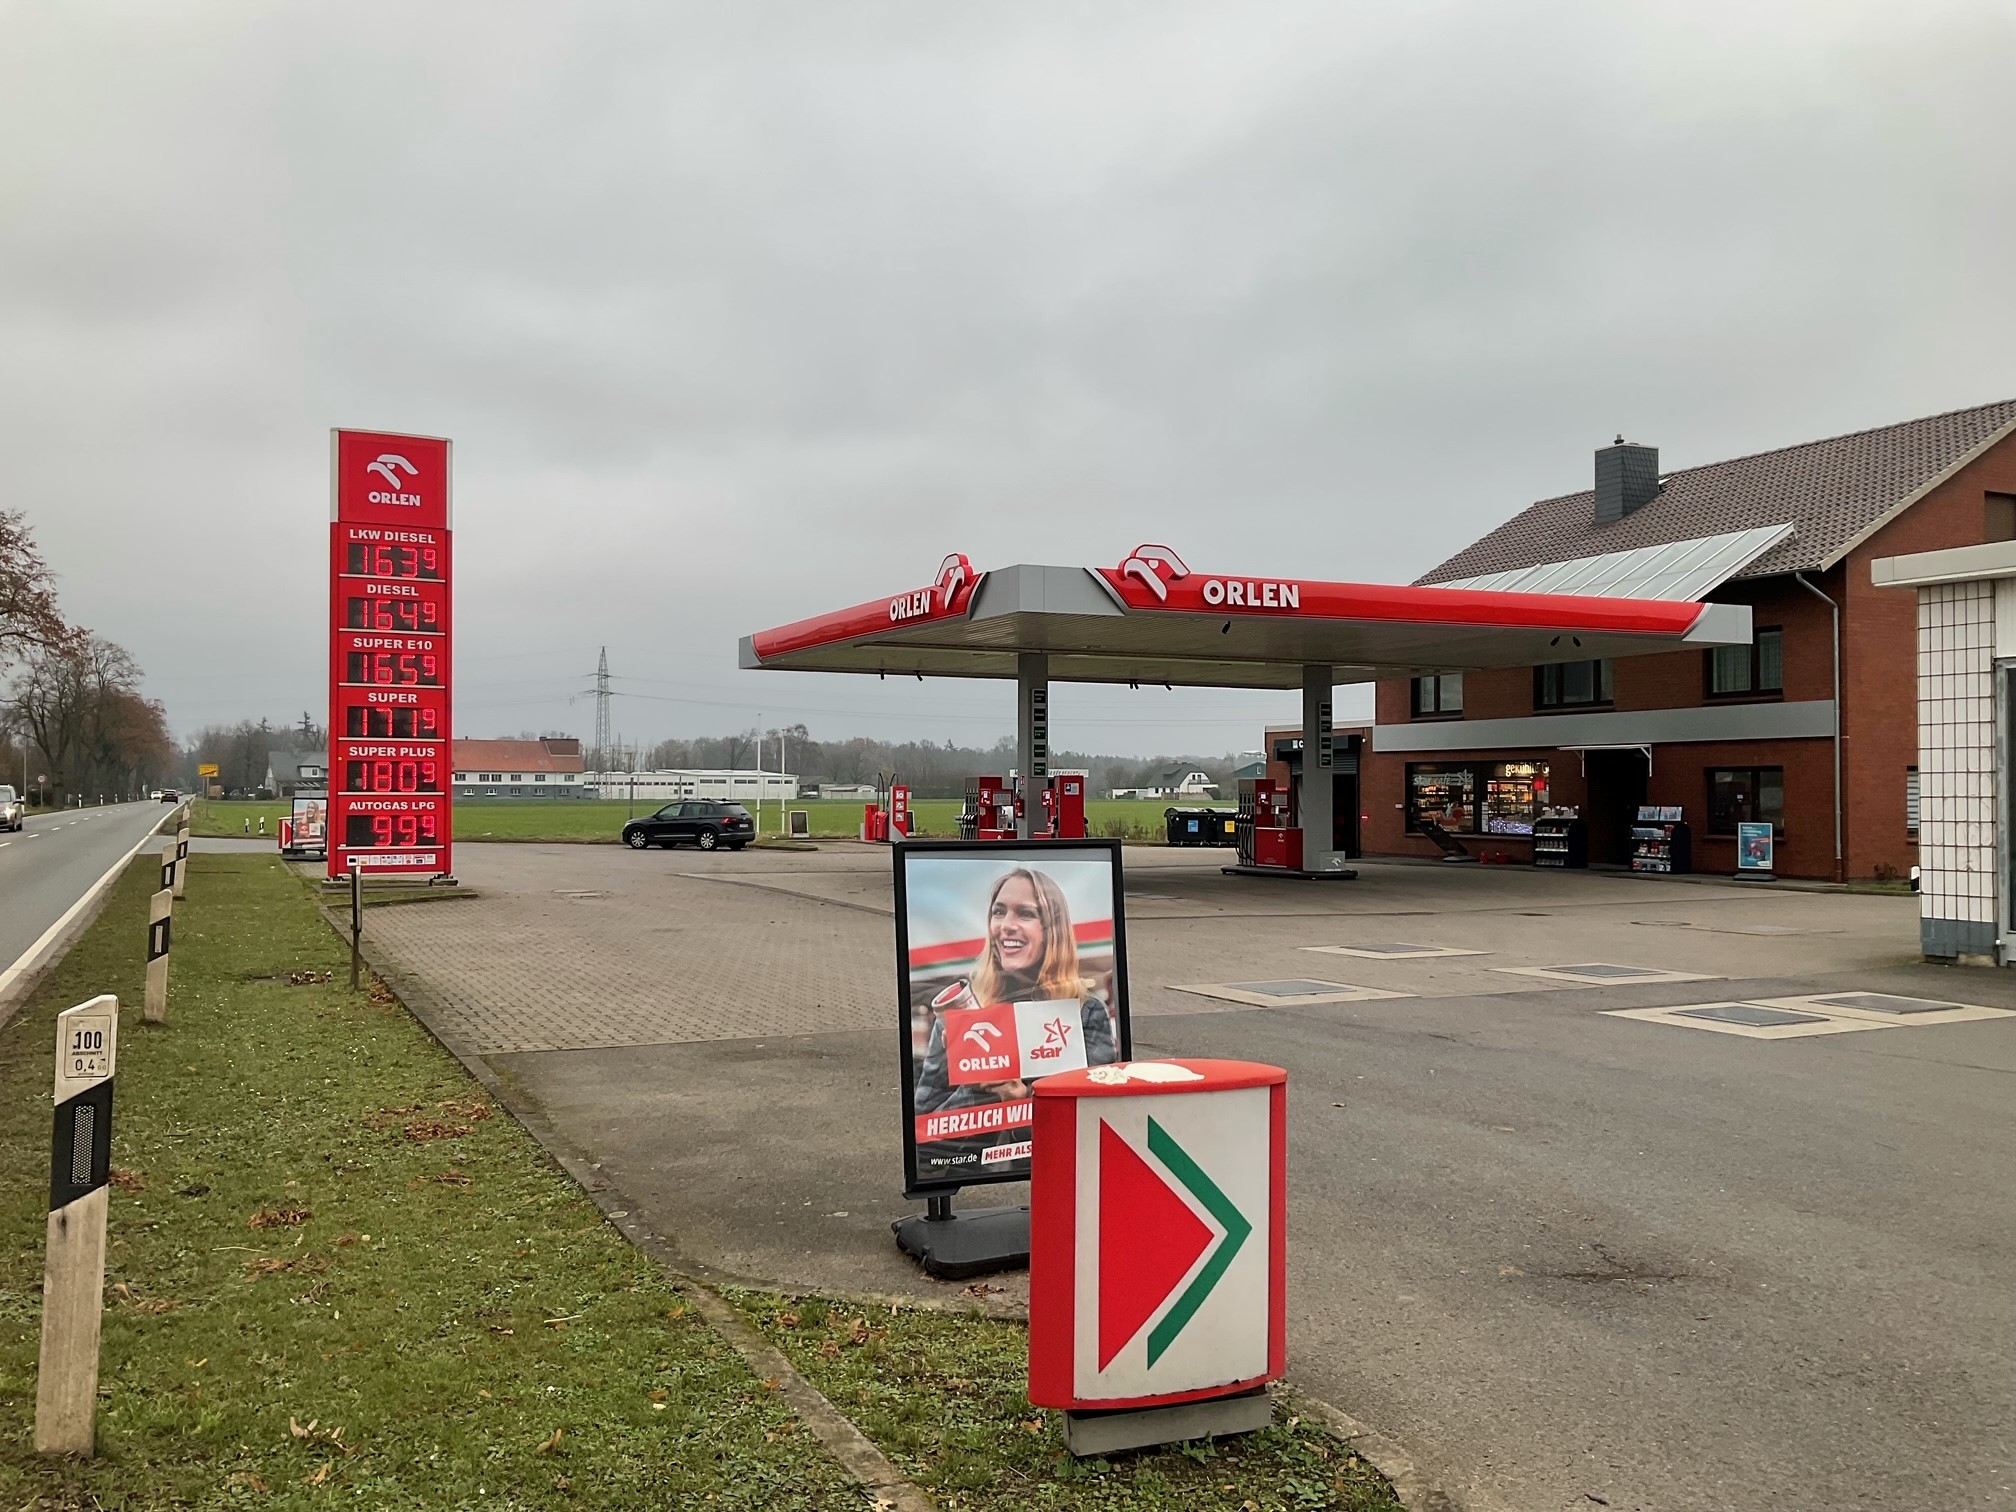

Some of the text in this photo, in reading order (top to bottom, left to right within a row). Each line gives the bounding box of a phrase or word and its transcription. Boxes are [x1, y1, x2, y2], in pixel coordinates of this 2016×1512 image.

[368, 491, 421, 507] ORLEN
[349, 529, 436, 544] LKW DIESEL
[362, 545, 436, 578] 1639
[366, 584, 419, 596] DIESEL
[1203, 580, 1300, 609] ORLEN
[362, 600, 436, 630] 1649
[889, 590, 931, 622] ORLEN
[353, 637, 433, 651] SUPER E10
[362, 653, 436, 685] 1659
[367, 692, 418, 703] SUPER
[362, 707, 436, 737] 1719
[349, 746, 436, 757] SUPER PLUS
[361, 761, 435, 792] 1809
[348, 801, 435, 811] AUTOGAS LPG
[372, 815, 435, 846] 999
[75, 1031, 102, 1049] 100
[1030, 1045, 1063, 1060] star
[959, 1055, 1010, 1072] ORLEN
[926, 1107, 1004, 1136] HERZLICH
[930, 1145, 1032, 1166] www.star.de MEHR ALS
